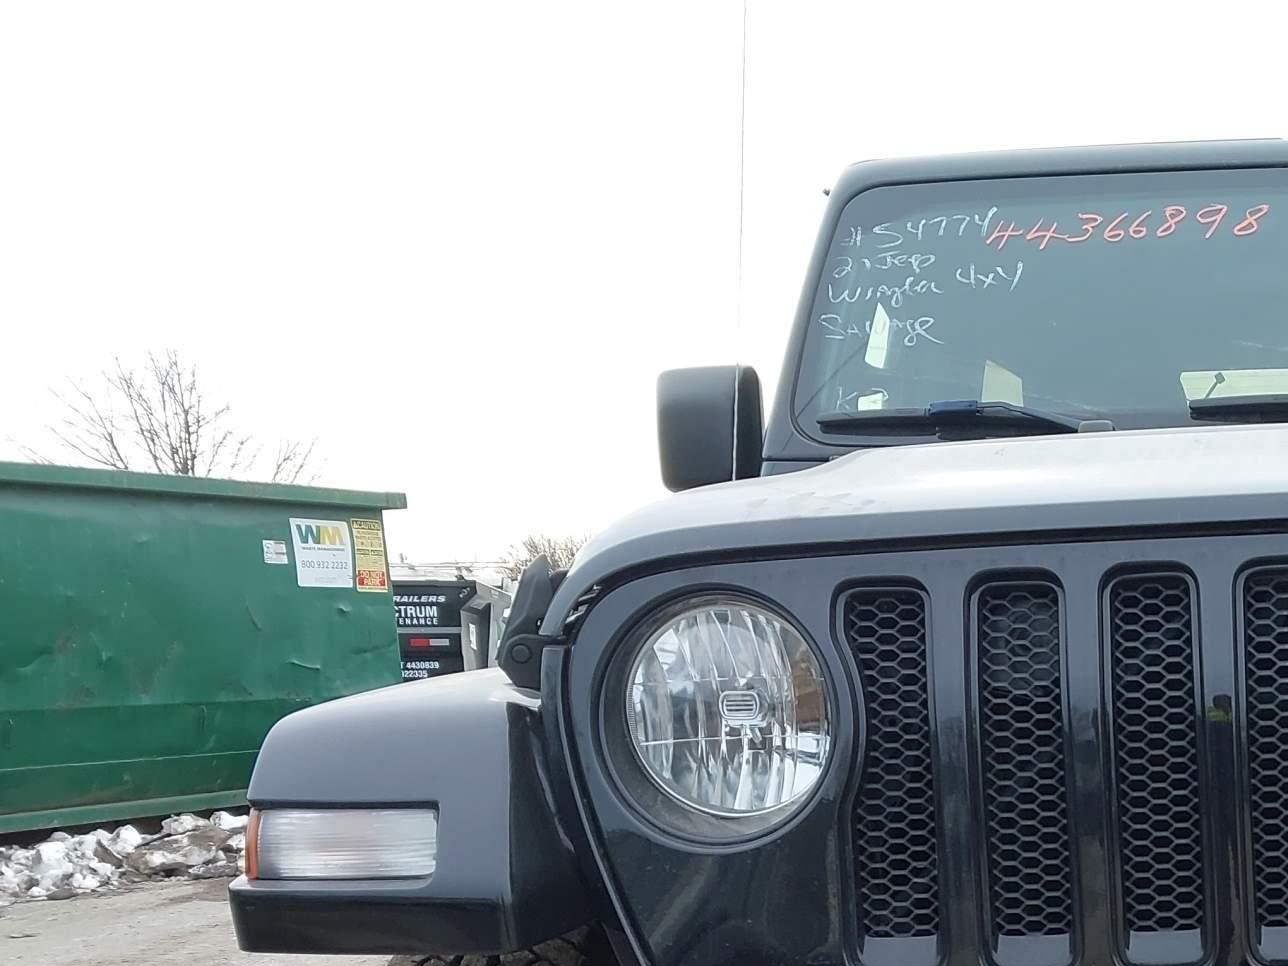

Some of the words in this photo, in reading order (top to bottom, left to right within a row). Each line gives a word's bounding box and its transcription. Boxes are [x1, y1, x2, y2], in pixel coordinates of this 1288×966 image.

[985, 203, 1270, 250] 44366898
[296, 524, 345, 546] WM
[301, 559, 315, 569] 800
[316, 560, 329, 569] 932
[331, 560, 349, 570] 2232
[393, 595, 447, 603] RAILERS
